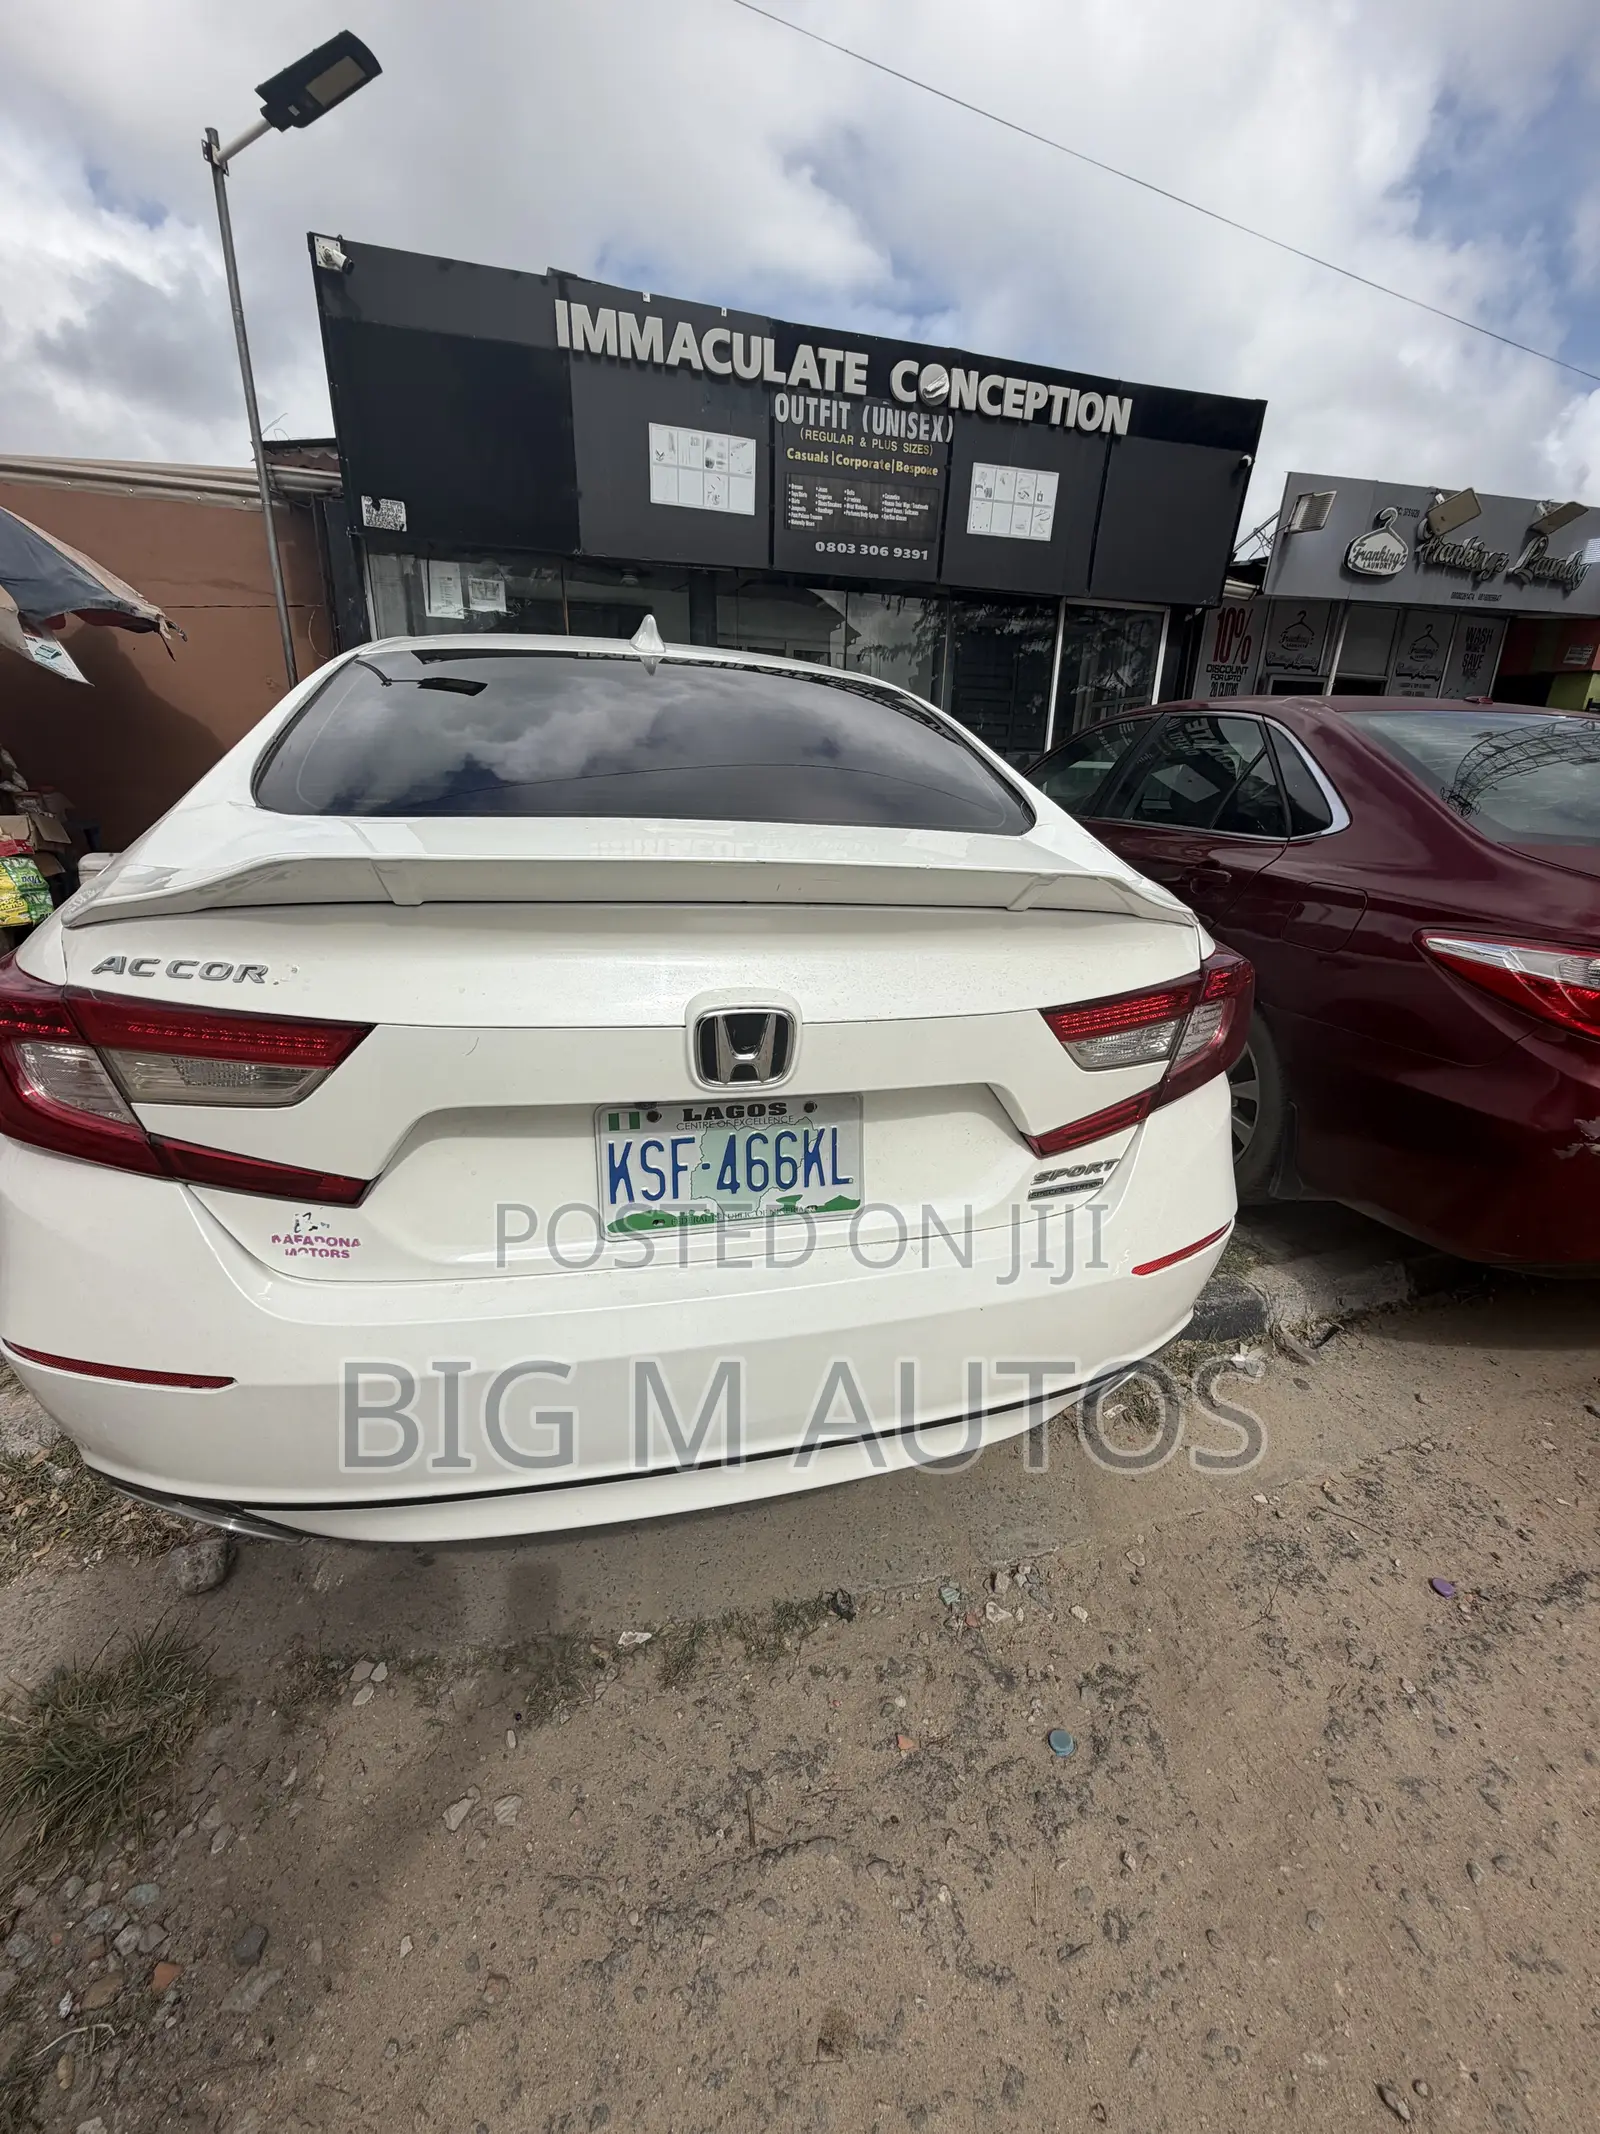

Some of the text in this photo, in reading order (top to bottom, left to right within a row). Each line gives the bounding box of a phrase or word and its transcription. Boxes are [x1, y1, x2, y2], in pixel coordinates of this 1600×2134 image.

[555, 299, 1132, 436] IMMACULATE CONCEPTION
[775, 393, 954, 443] OUTFIT (UNISEX)
[800, 427, 933, 456] (REGULAR & PLUS SIZES)
[786, 447, 829, 464] Casuals
[815, 541, 928, 560] 0803 306 9391
[1213, 607, 1254, 665] 10%
[1466, 627, 1494, 644] WASH
[1206, 664, 1249, 675] DISCOUNT
[1462, 653, 1484, 670] SAVE
[91, 955, 270, 984] ACCOR
[676, 1115, 795, 1131] CENTRE OF EXCELLENCE
[683, 1102, 788, 1122] LAGOS
[608, 1128, 854, 1205] KSF-466KL
[1031, 1158, 1121, 1185] SPORT
